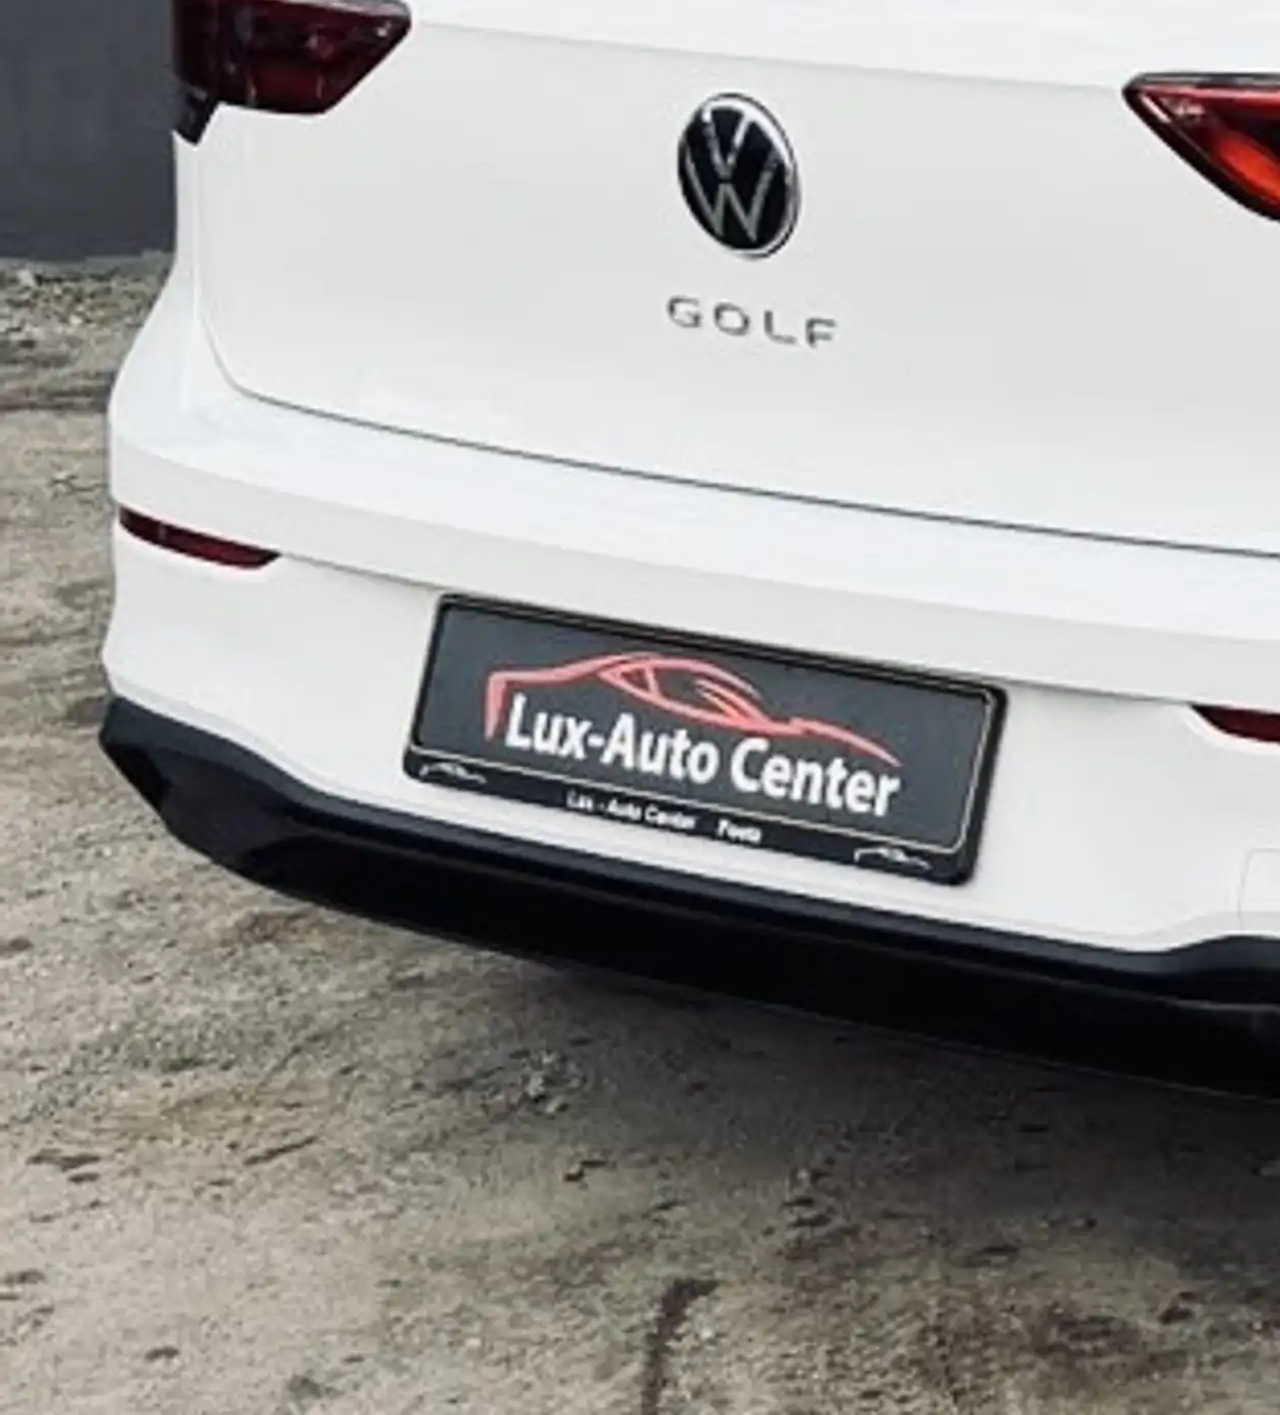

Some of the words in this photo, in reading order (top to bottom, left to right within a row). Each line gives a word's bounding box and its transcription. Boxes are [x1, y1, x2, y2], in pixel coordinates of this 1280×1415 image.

[666, 294, 838, 348] GOLF
[506, 693, 719, 784] Lux-Auto
[730, 737, 899, 817] Center
